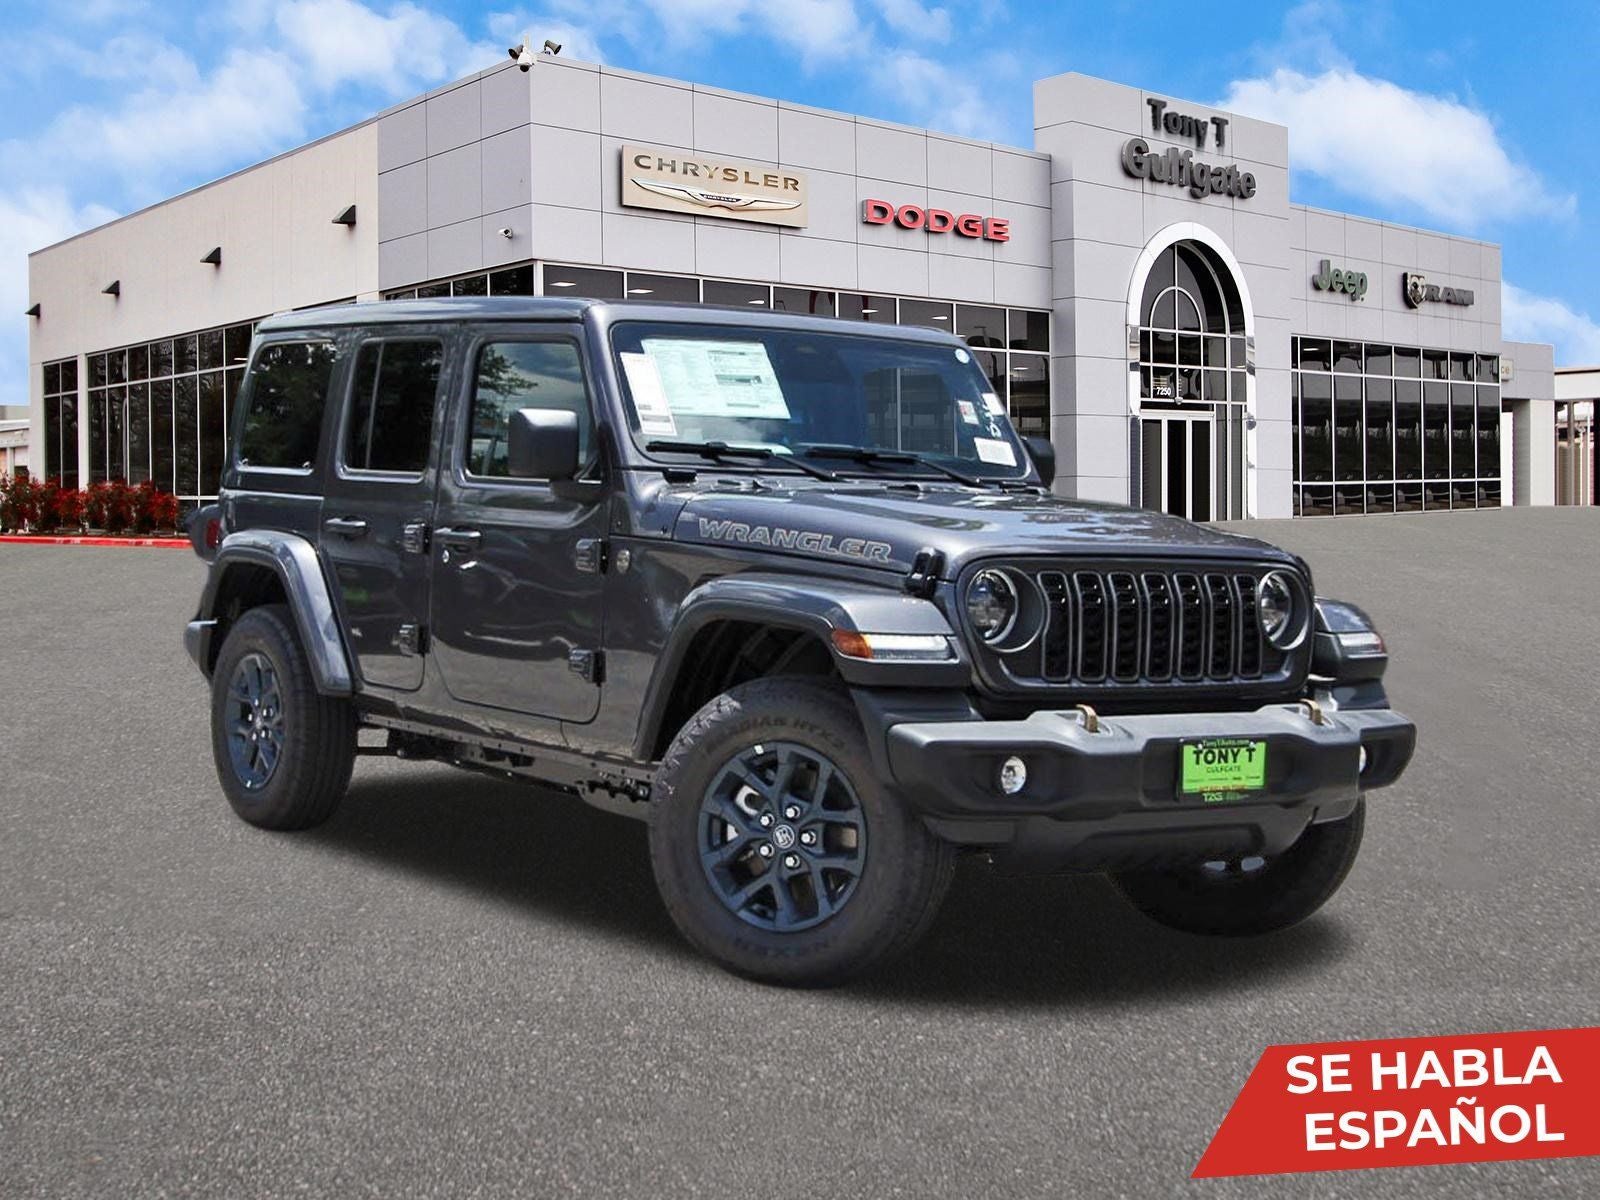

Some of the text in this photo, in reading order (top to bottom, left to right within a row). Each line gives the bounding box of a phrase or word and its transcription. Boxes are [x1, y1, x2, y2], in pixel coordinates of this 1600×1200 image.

[1147, 98, 1229, 148] Tony T
[633, 154, 800, 191] CHRYSLER
[1121, 138, 1256, 199] Gulfgate
[862, 198, 1010, 242] DODGE
[1312, 259, 1368, 301] Jeep
[1424, 284, 1474, 306] RAM
[698, 518, 892, 563] WRANGLER
[1193, 747, 1257, 766] TONY T
